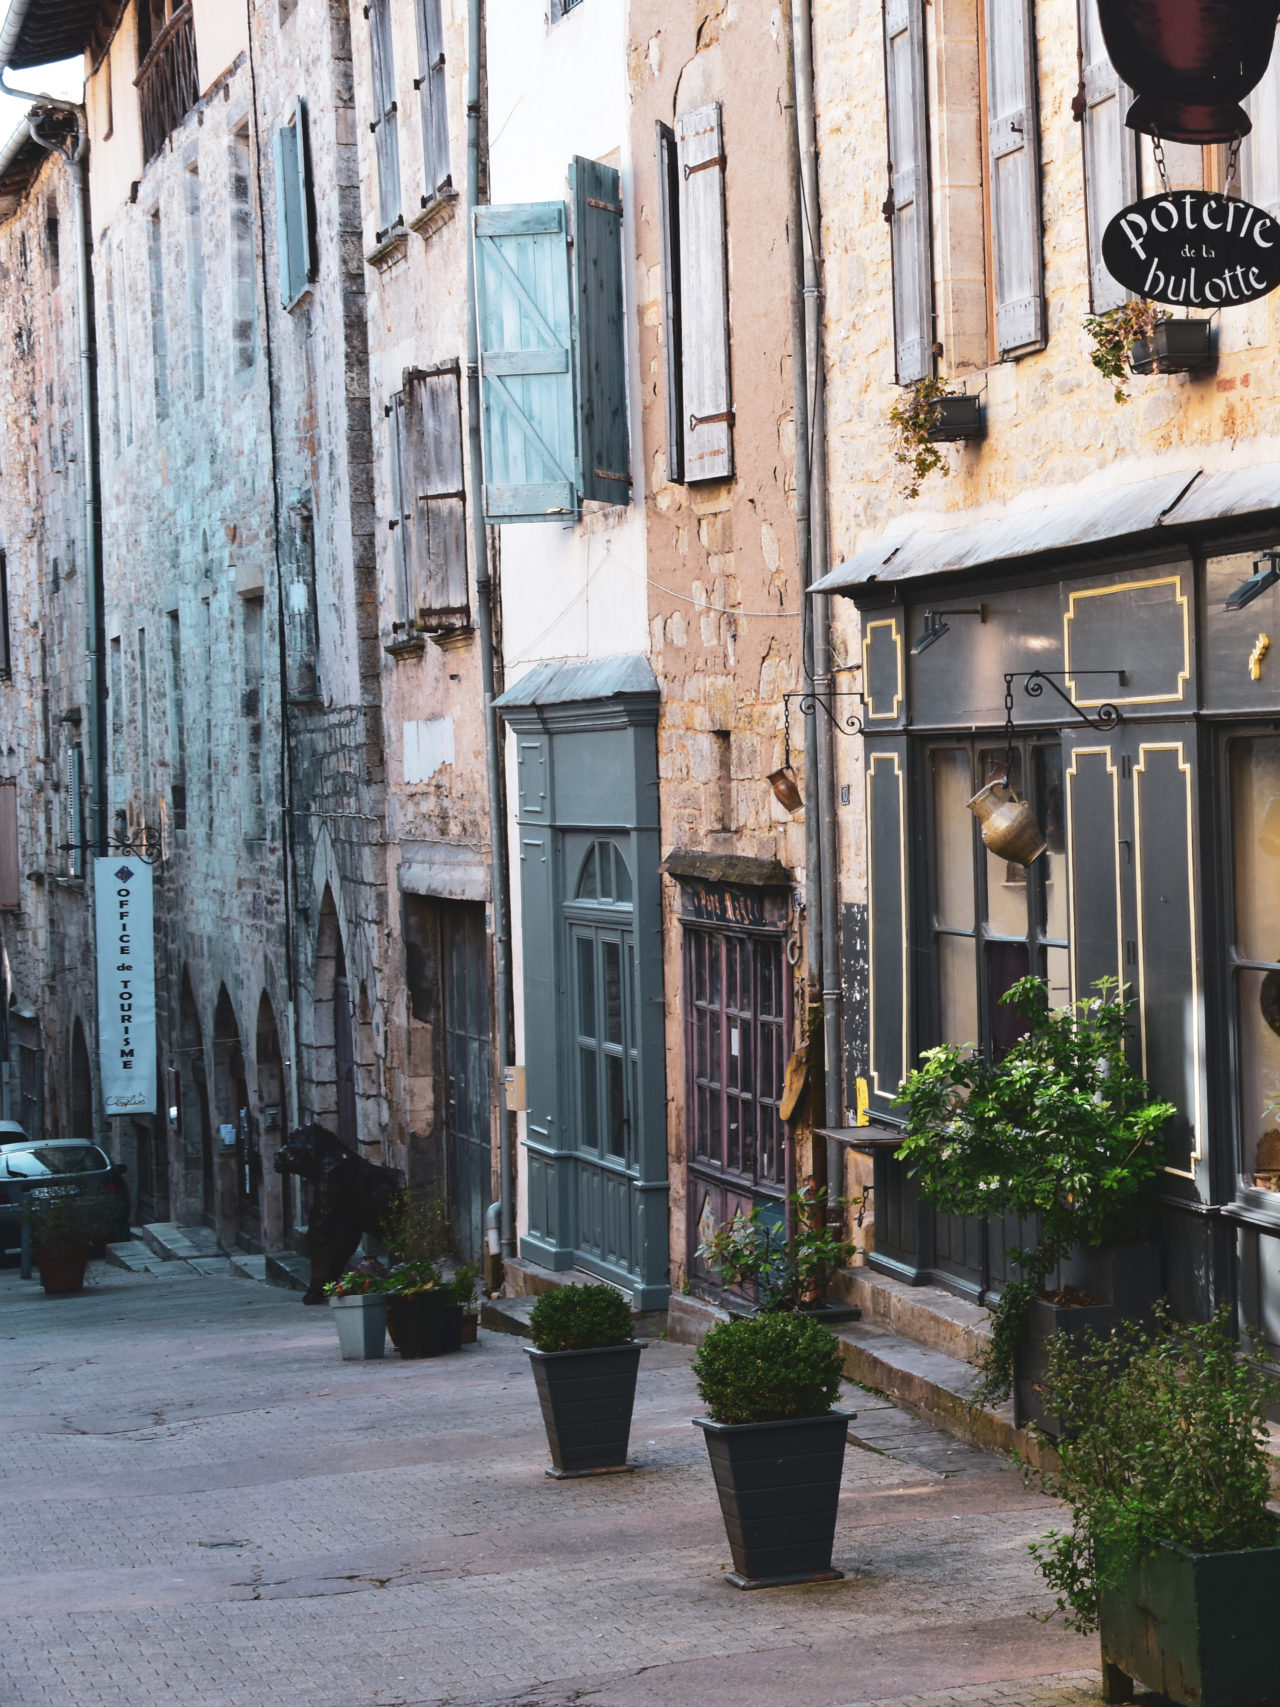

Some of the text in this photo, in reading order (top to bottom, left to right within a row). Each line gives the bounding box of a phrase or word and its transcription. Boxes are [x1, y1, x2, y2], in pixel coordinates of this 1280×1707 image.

[1180, 244, 1195, 258] de
[1144, 257, 1267, 303] hulotte
[116, 888, 136, 1070] OFFICE de TOURISME
